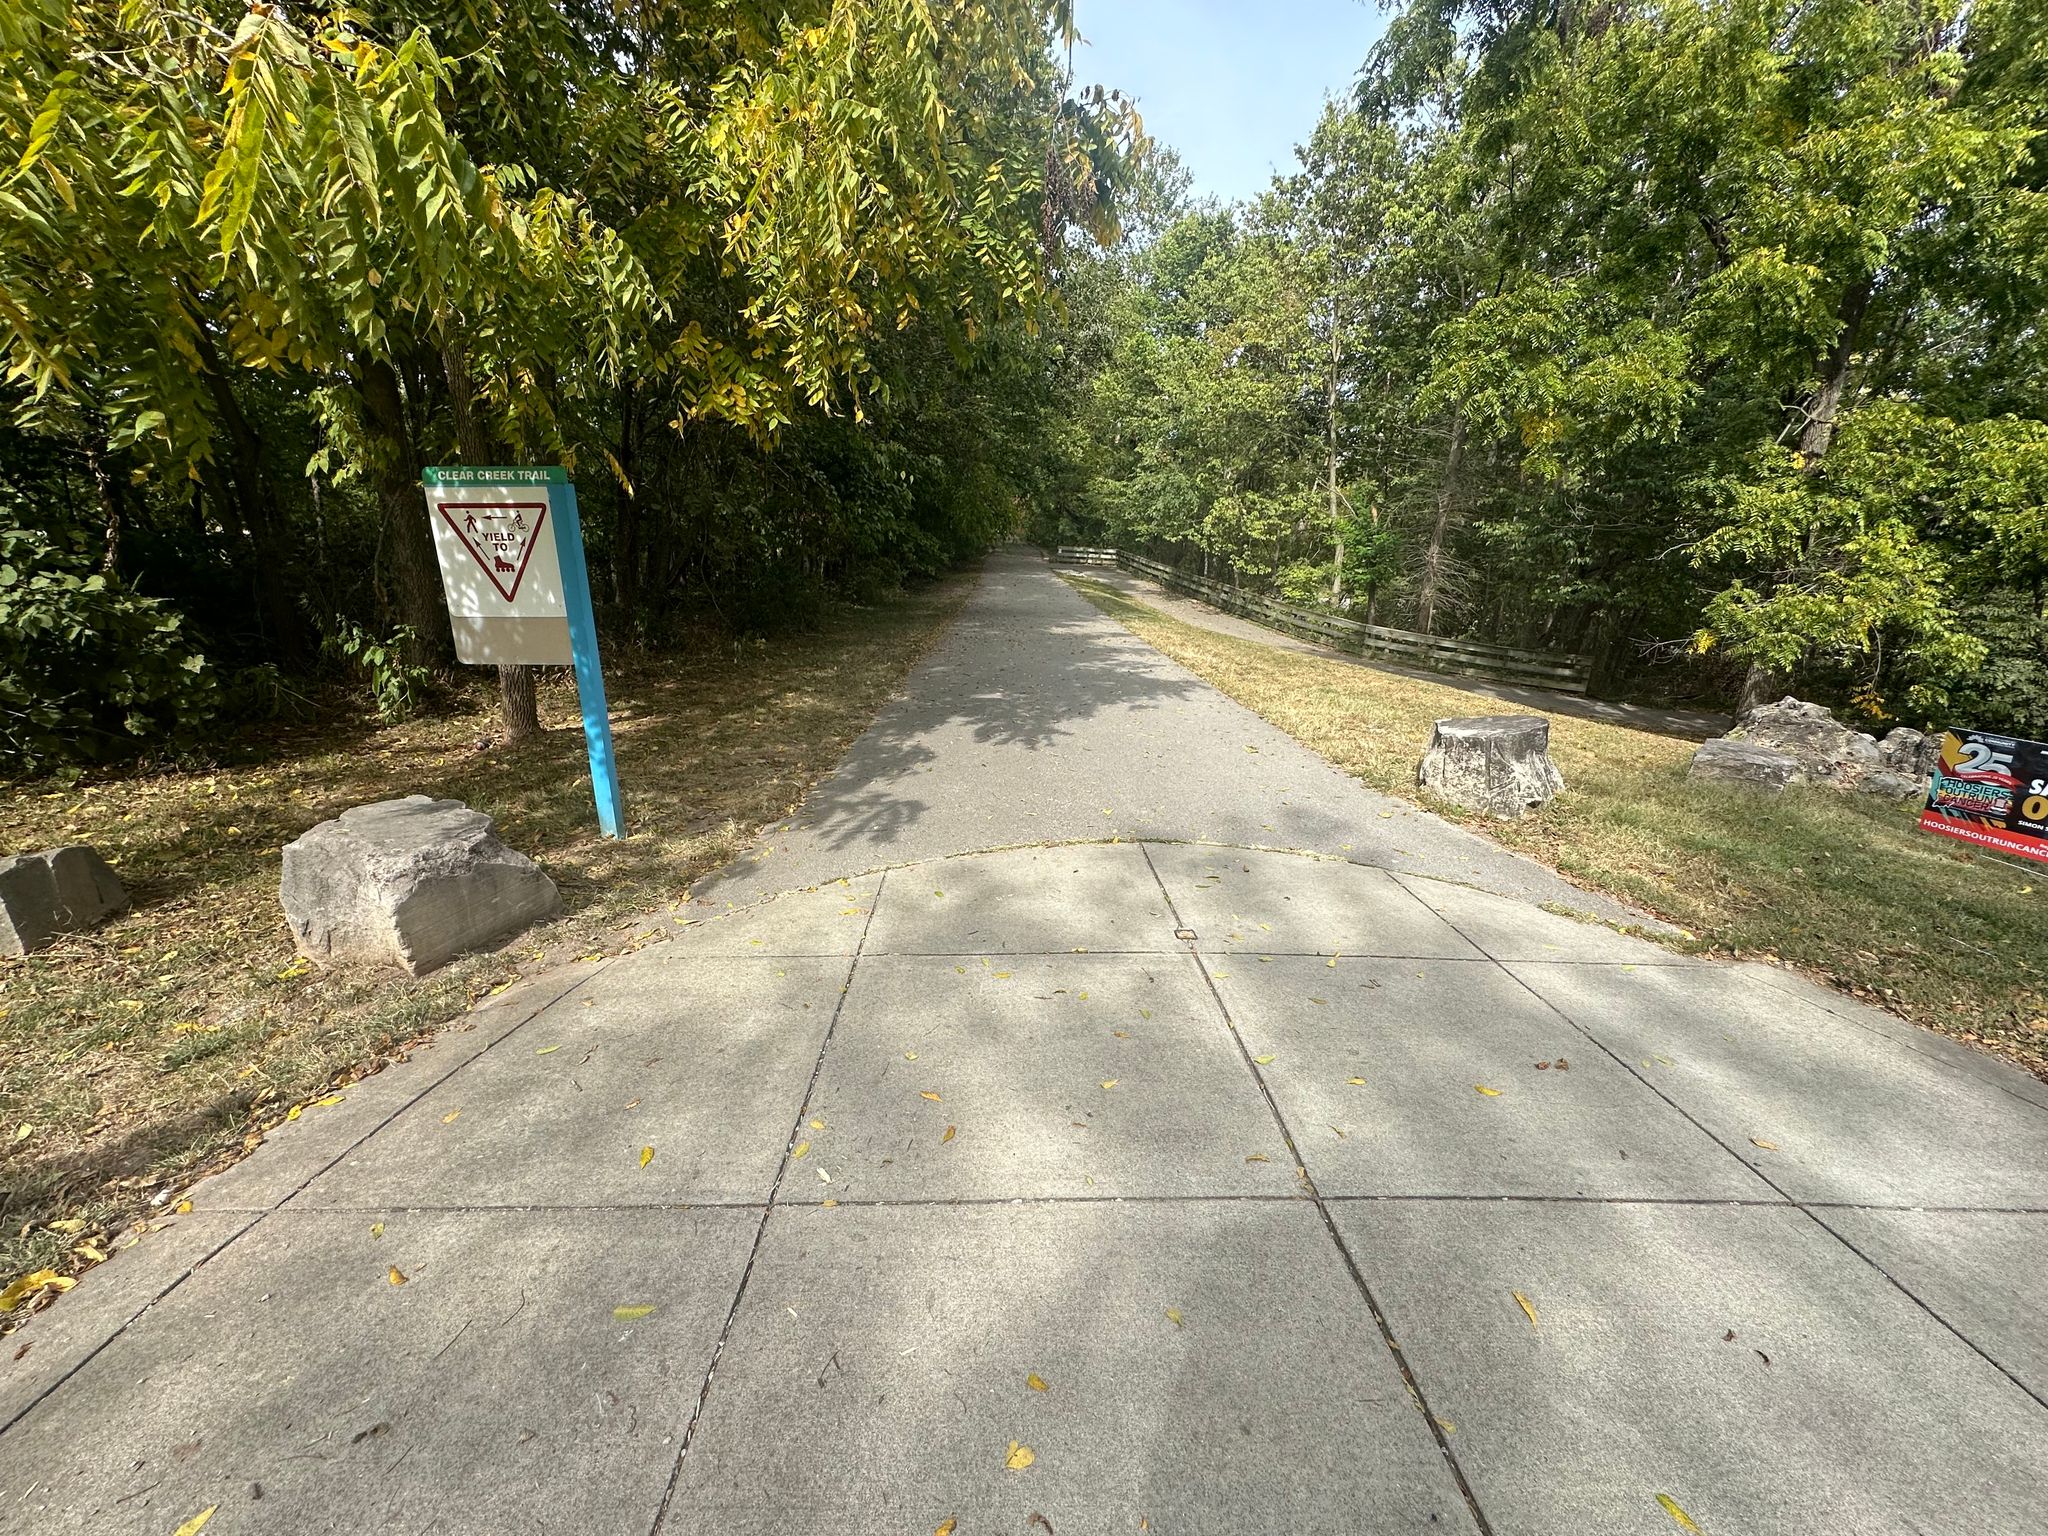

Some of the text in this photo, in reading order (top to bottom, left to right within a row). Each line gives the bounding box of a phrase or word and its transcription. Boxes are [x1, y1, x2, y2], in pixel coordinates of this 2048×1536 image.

[438, 471, 550, 481] CLEAR CREEK TRAIL
[482, 532, 515, 542] YIELD
[492, 543, 508, 552] TO
[1954, 743, 2014, 778] 25
[1945, 787, 1994, 804] OUTRUN
[1947, 780, 2010, 798] HOOSIERS
[1943, 795, 1989, 810] CANCER
[2017, 820, 2044, 831] SIMON
